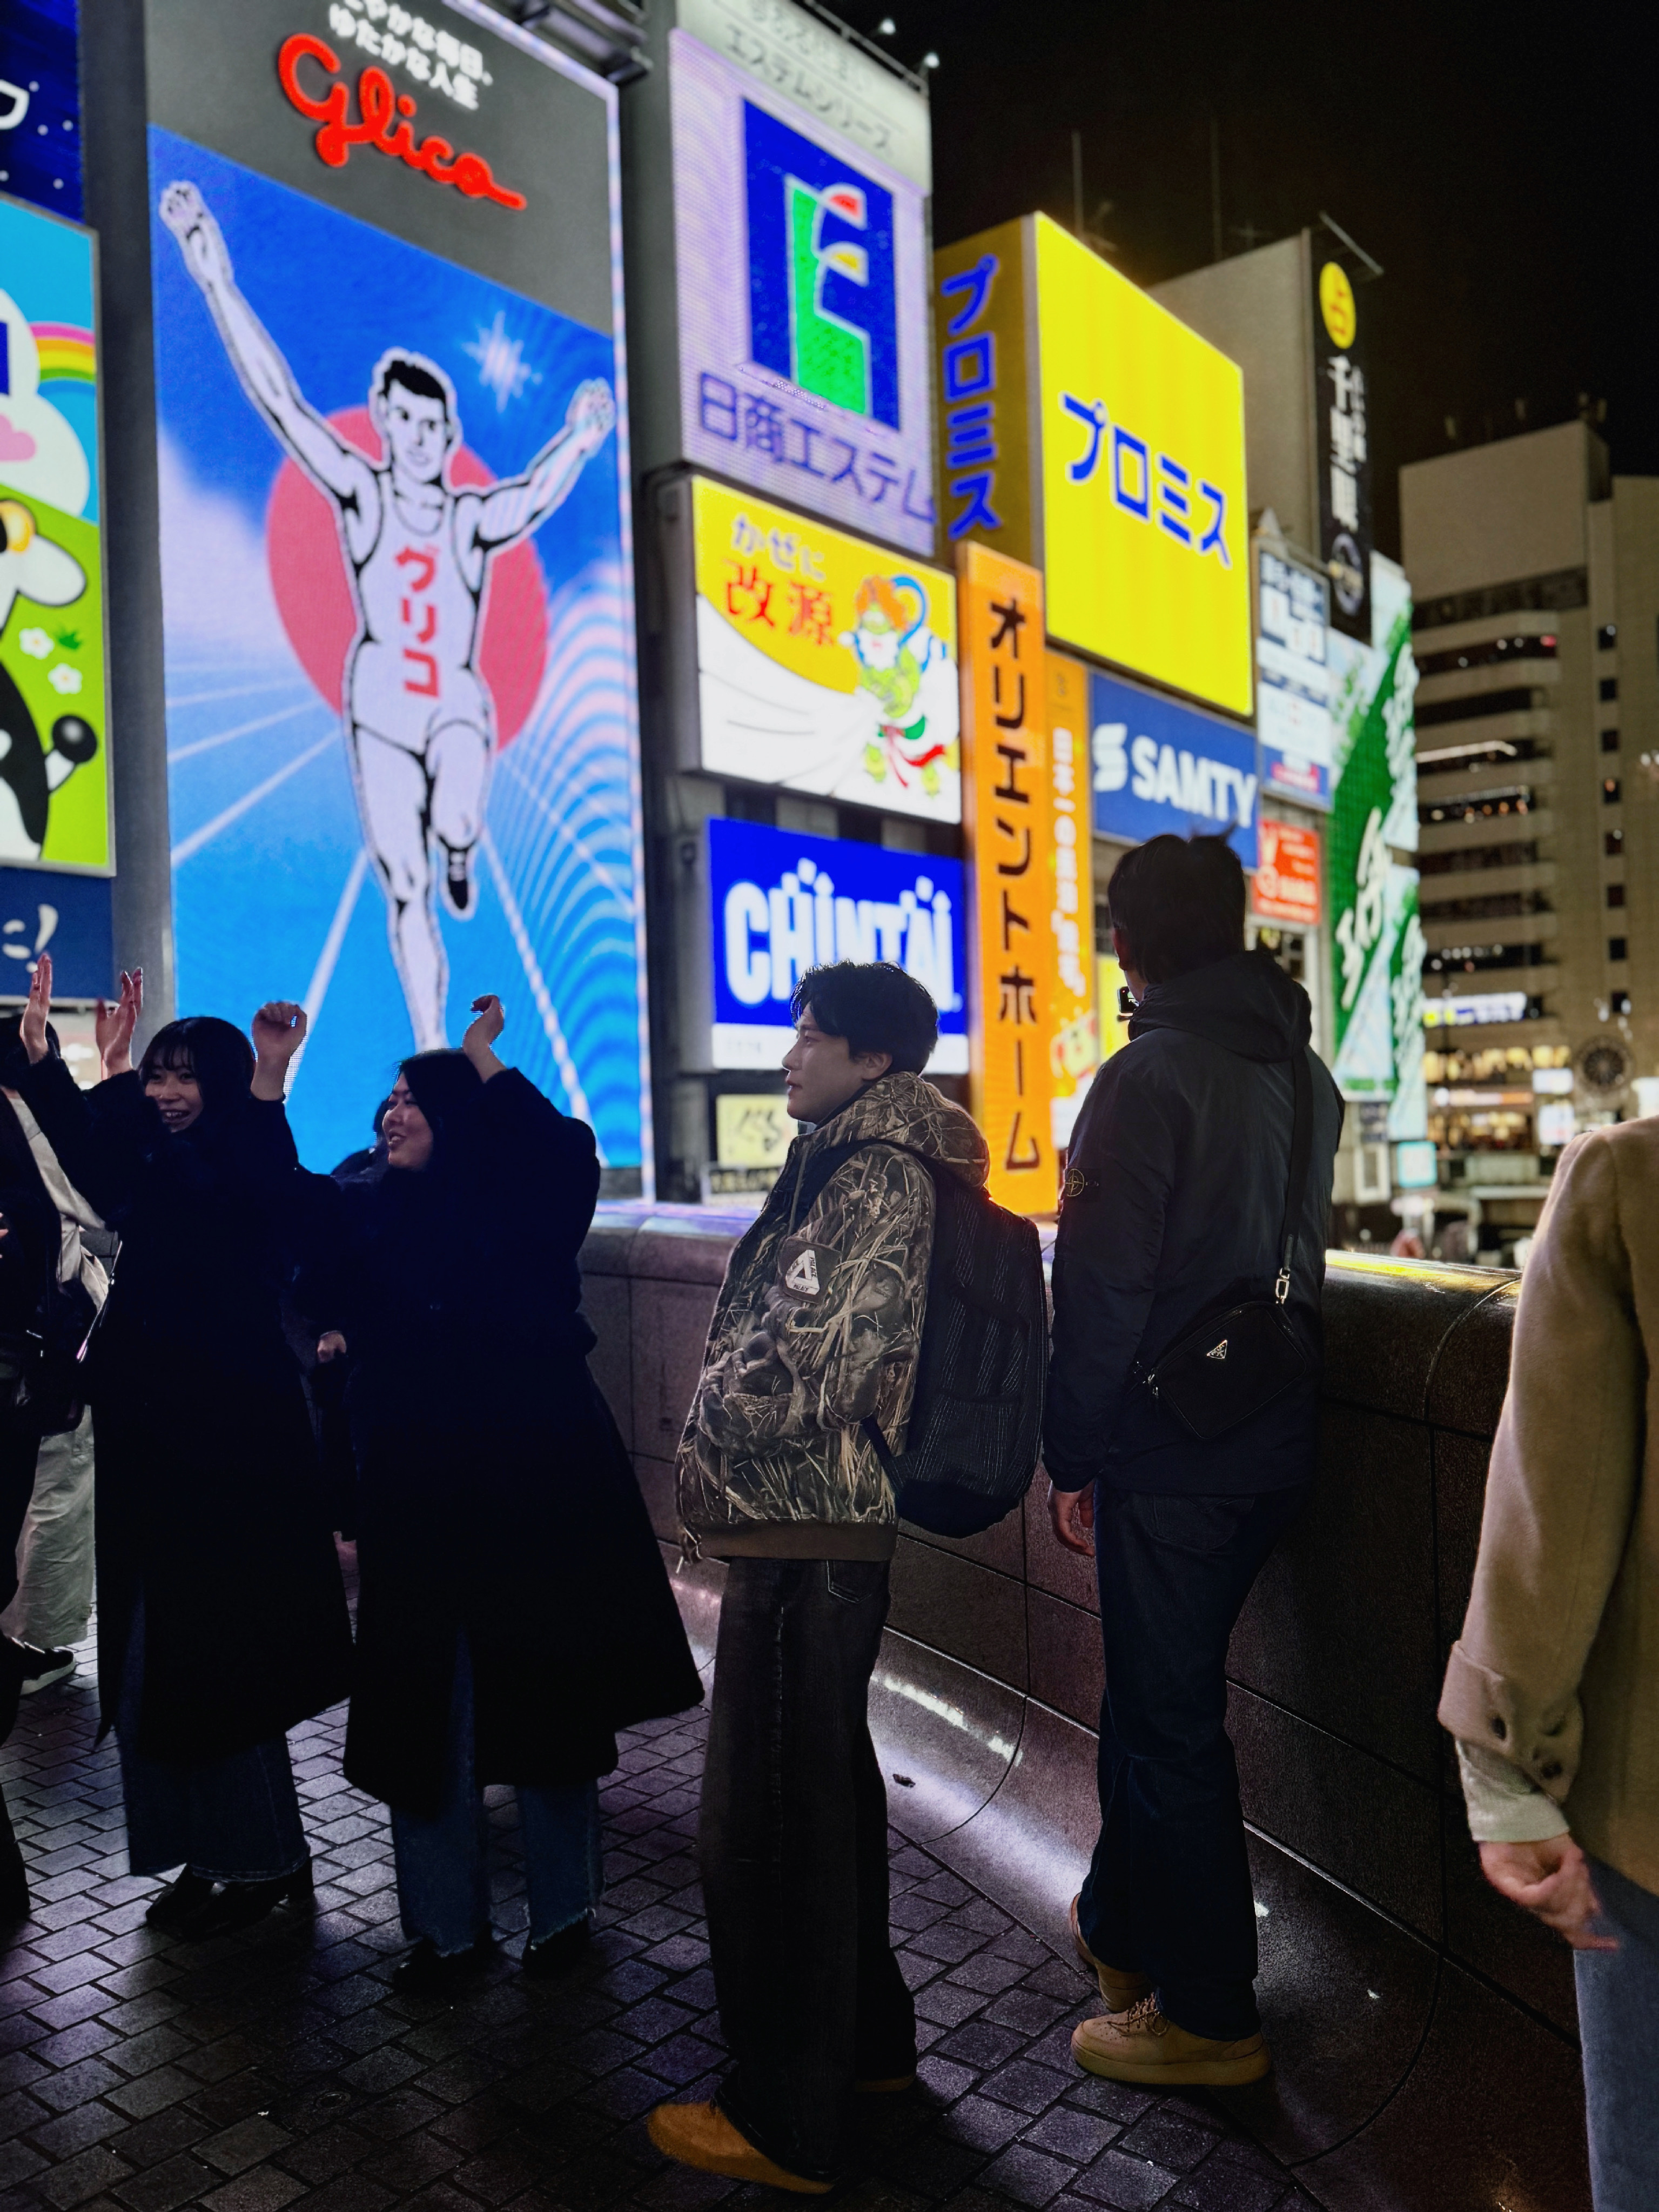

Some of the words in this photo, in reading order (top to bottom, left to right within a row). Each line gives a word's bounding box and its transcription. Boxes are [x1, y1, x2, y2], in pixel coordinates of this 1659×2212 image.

[278, 32, 528, 212] Glico
[700, 373, 937, 524] 日商エステム
[941, 252, 1003, 541] プロミス
[1060, 392, 1232, 569] プロミス
[394, 543, 440, 698] グリコ
[722, 558, 835, 647] 改源
[1132, 735, 1258, 828] SAMTY
[724, 858, 954, 1012] CHINTAI
[990, 598, 1040, 1170] オリエントホーム
